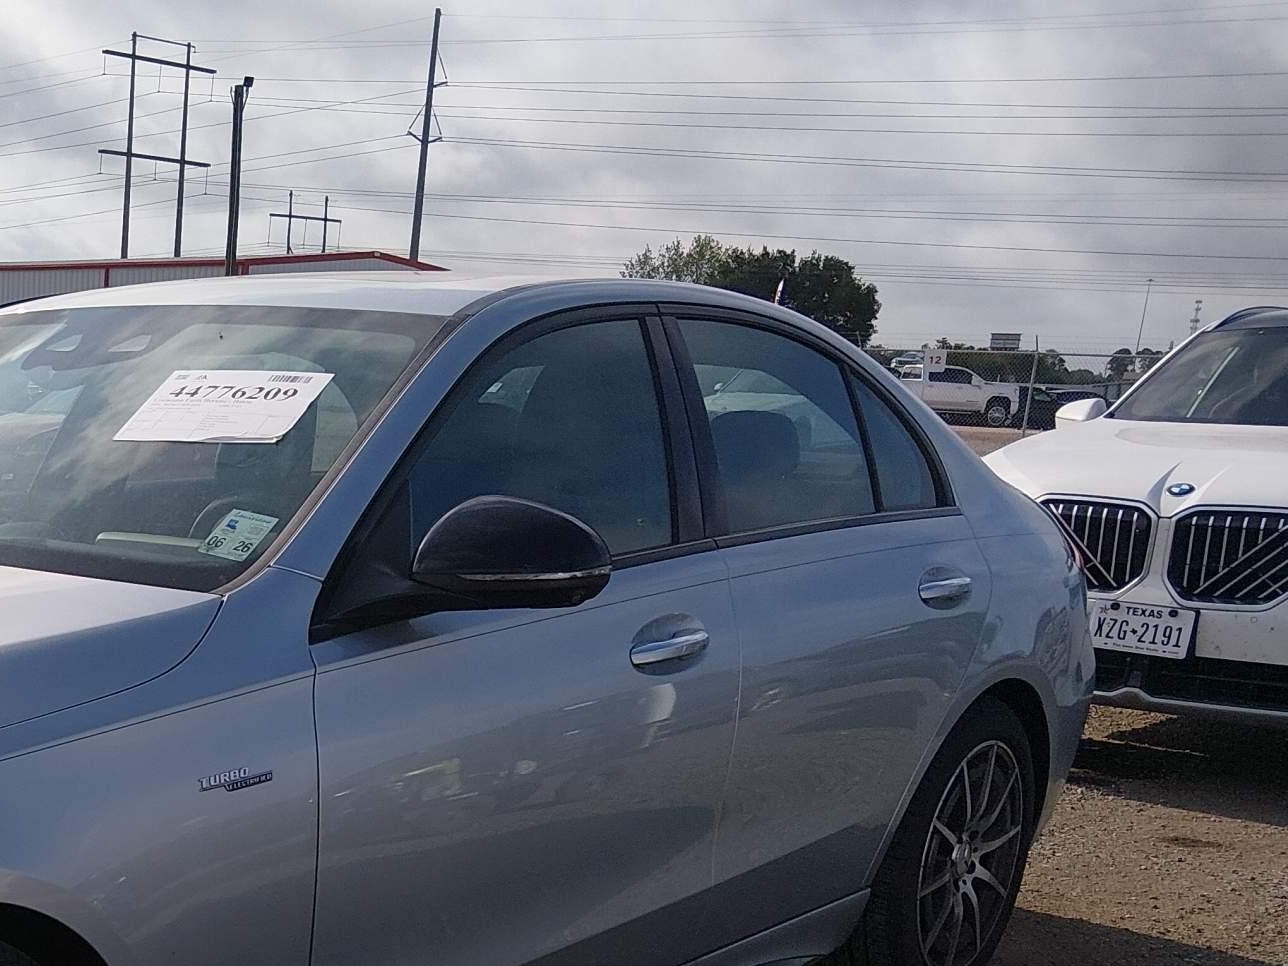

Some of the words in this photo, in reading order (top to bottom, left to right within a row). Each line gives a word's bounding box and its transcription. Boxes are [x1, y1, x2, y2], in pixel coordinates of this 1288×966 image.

[929, 355, 942, 365] 12
[169, 385, 298, 401] 44776209
[207, 535, 226, 548] 06
[233, 541, 253, 553] 26
[1126, 606, 1164, 619] TEXAS
[199, 767, 249, 789] TURBO
